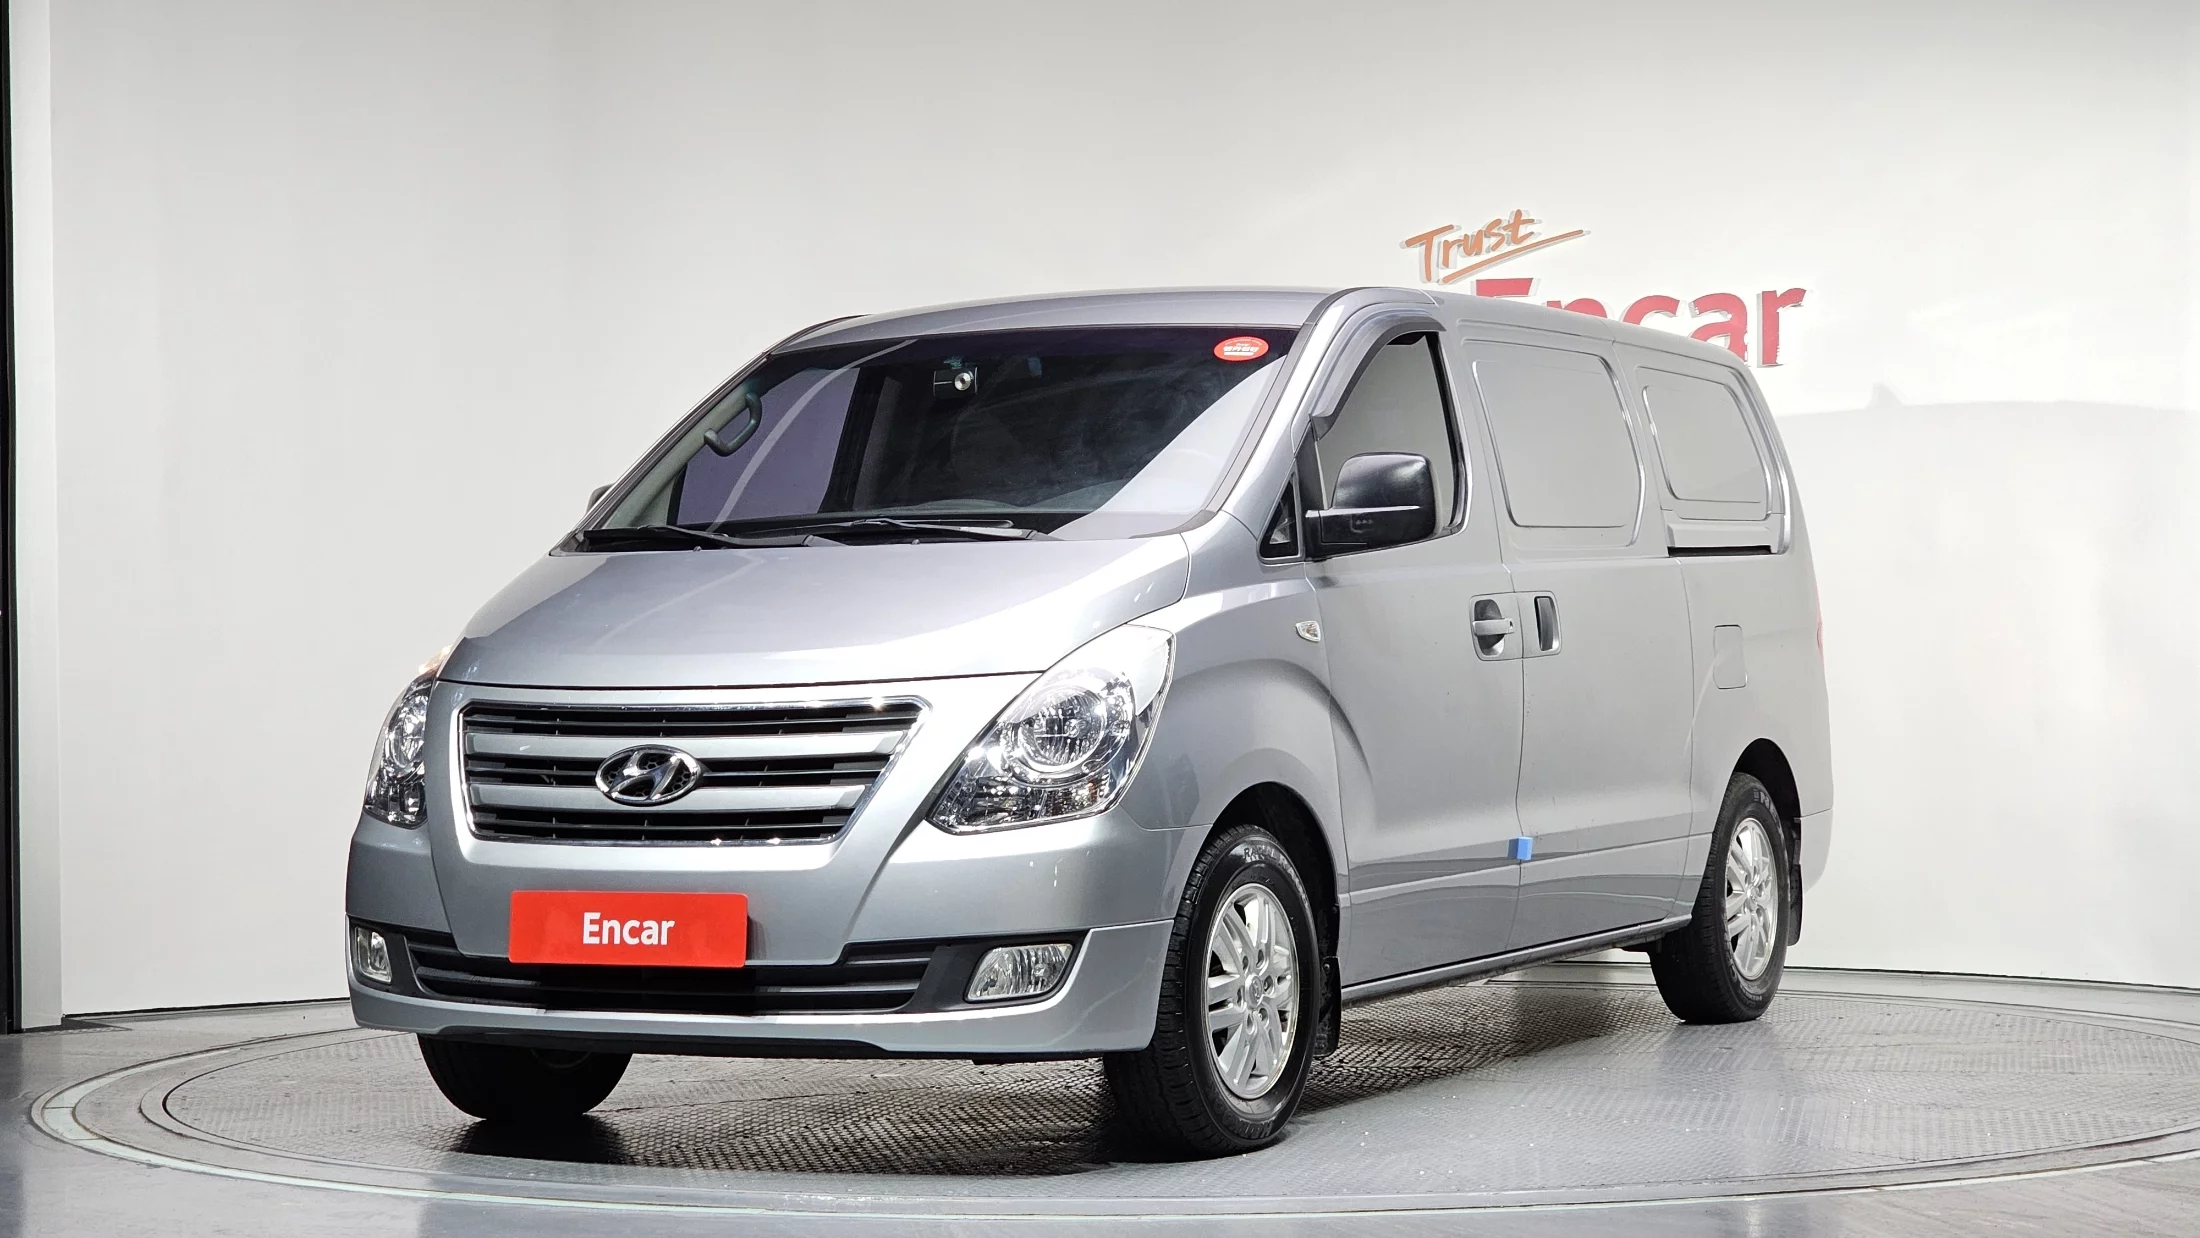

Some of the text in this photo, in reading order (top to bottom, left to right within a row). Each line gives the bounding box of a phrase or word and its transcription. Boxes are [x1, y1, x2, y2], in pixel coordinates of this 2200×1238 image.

[1404, 208, 1536, 283] Trust
[1475, 277, 1807, 366] car
[583, 912, 676, 945] Encar
